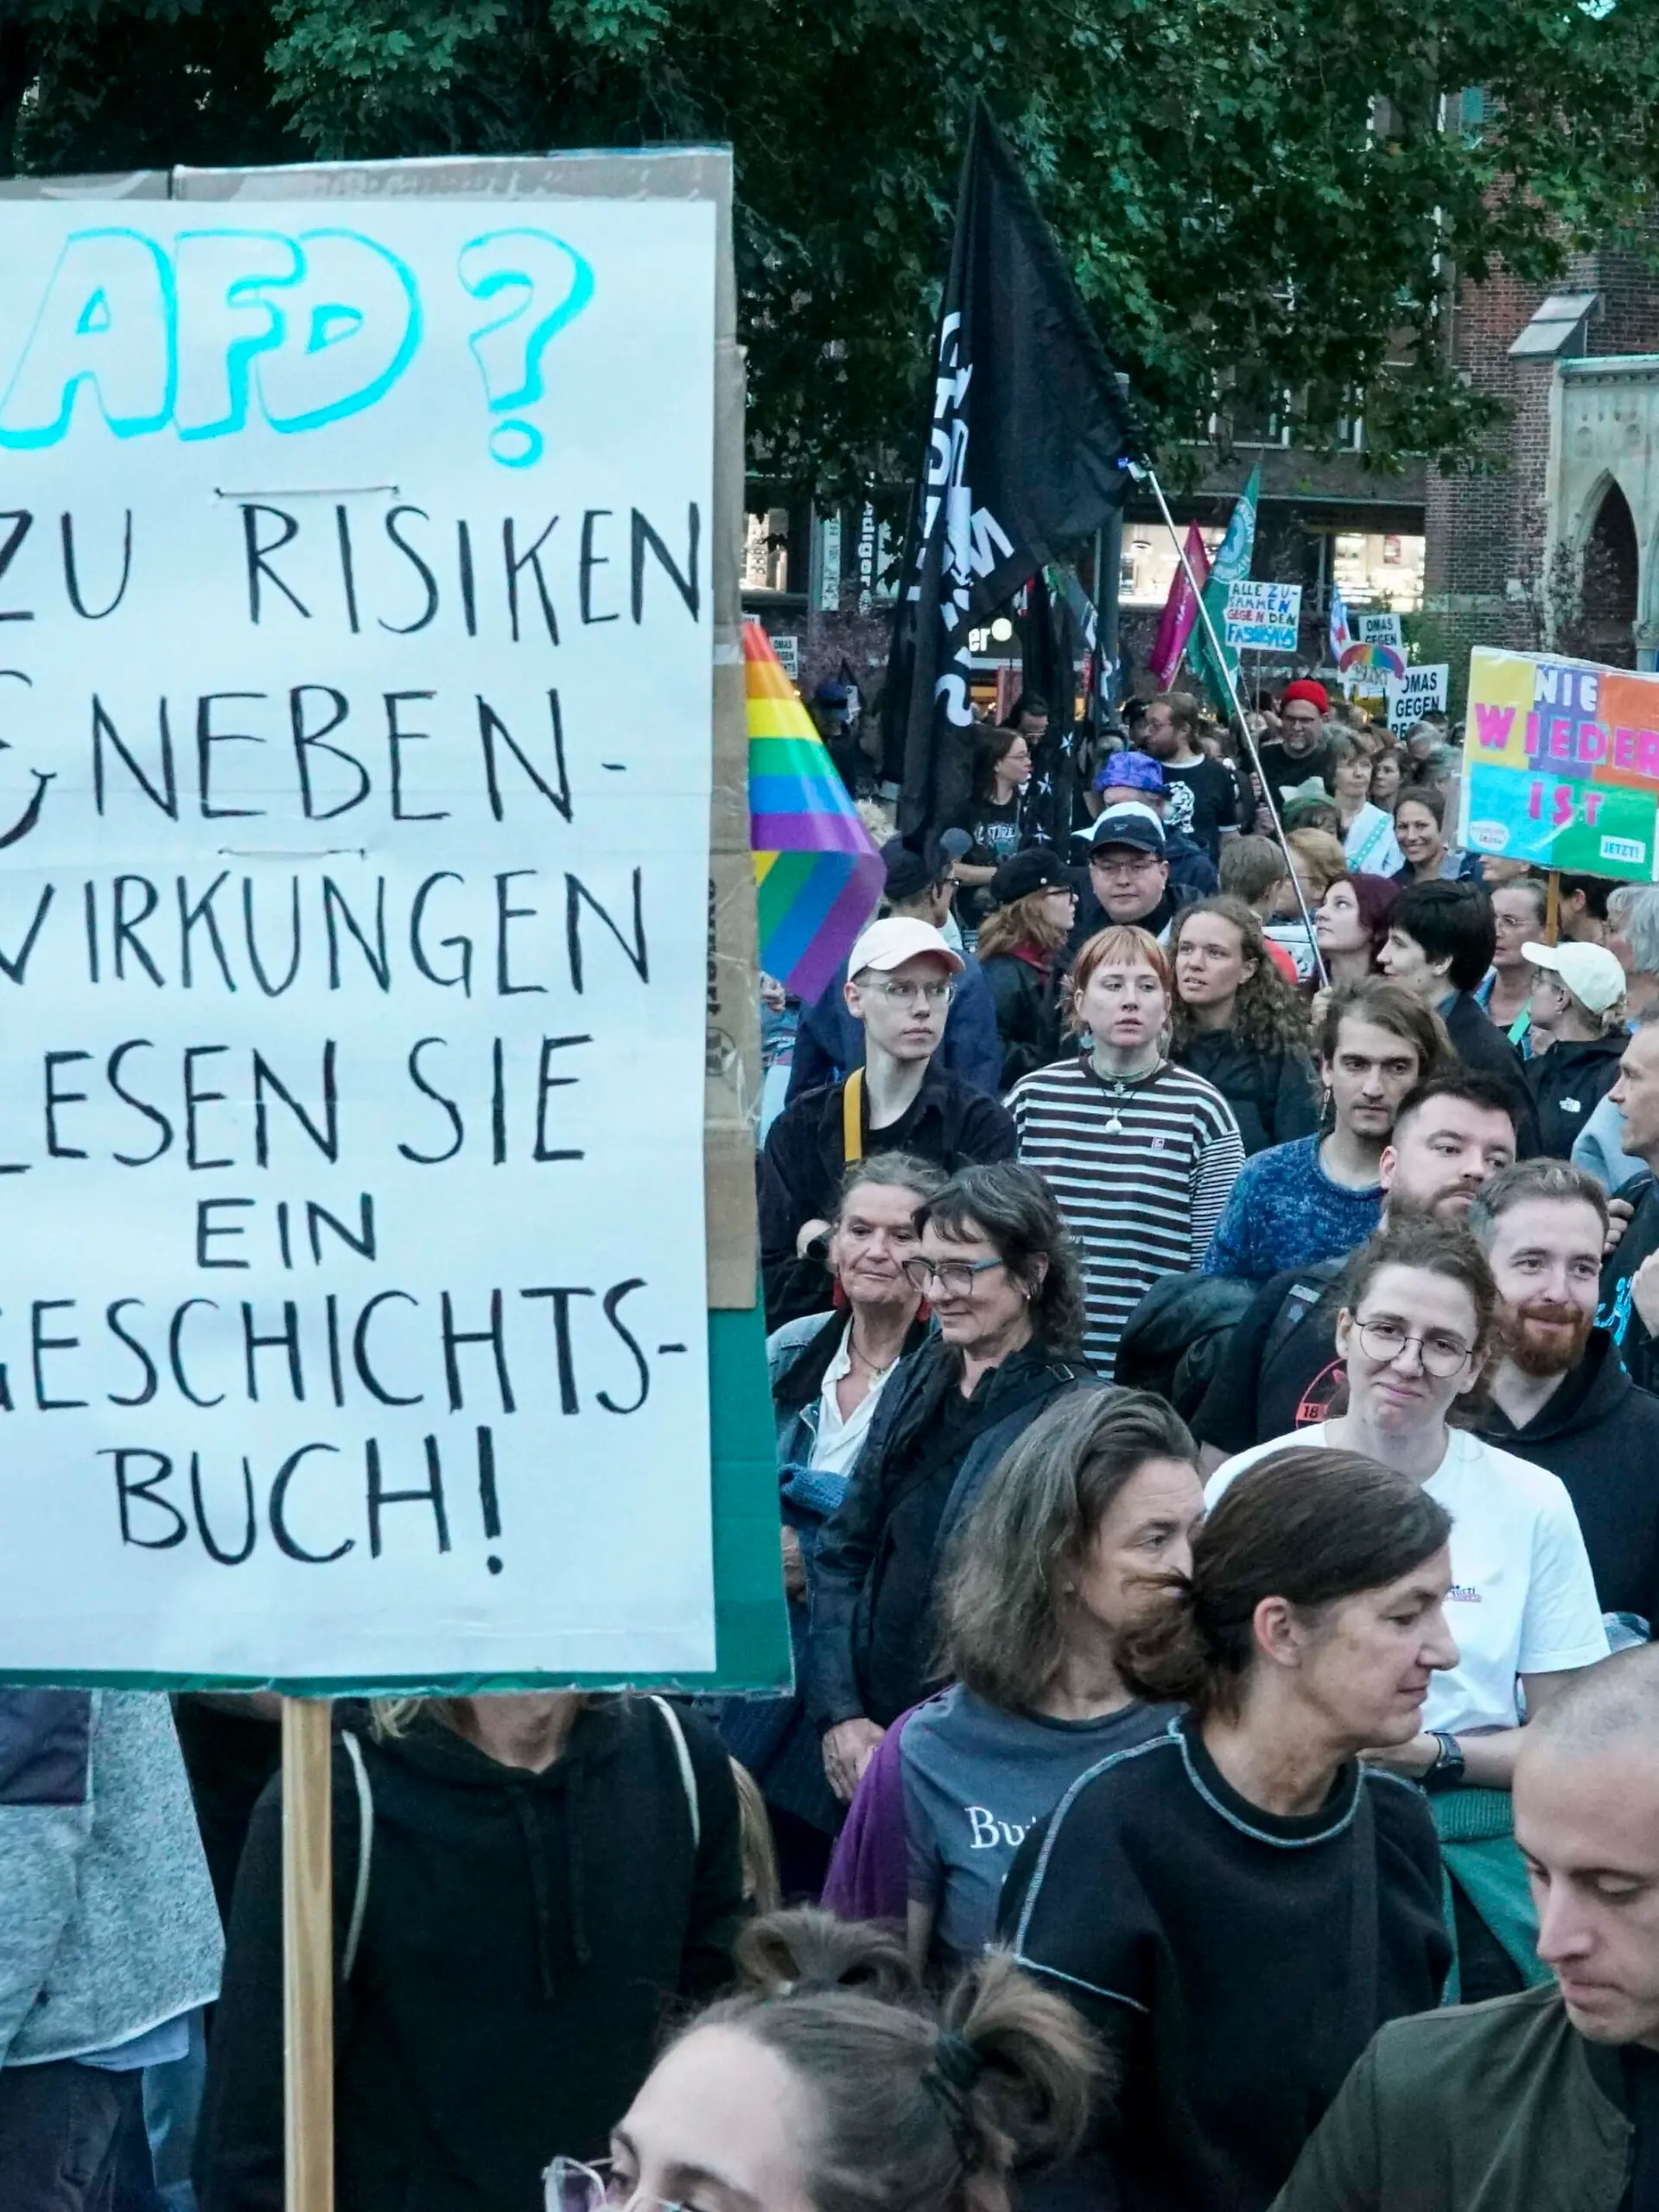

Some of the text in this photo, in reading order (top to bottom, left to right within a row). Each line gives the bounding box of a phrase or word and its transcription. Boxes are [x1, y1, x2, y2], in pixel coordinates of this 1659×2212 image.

[0, 226, 424, 451] AFD
[240, 501, 702, 649] RISIKEN
[1232, 582, 1262, 597] ALLE
[1227, 608, 1298, 626] GEGEN DEN
[1365, 618, 1394, 632] OMAS
[1534, 668, 1599, 713] NIE
[92, 684, 626, 823] NEBEN-
[1473, 702, 1659, 781] WIEDER
[1528, 781, 1605, 829] IST
[1603, 841, 1640, 861] JETZT!
[0, 1033, 593, 1176] ESEN SIE
[196, 1192, 376, 1269] EIN
[97, 1425, 505, 1576] BUCH!
[964, 1806, 1037, 1849] Bu
